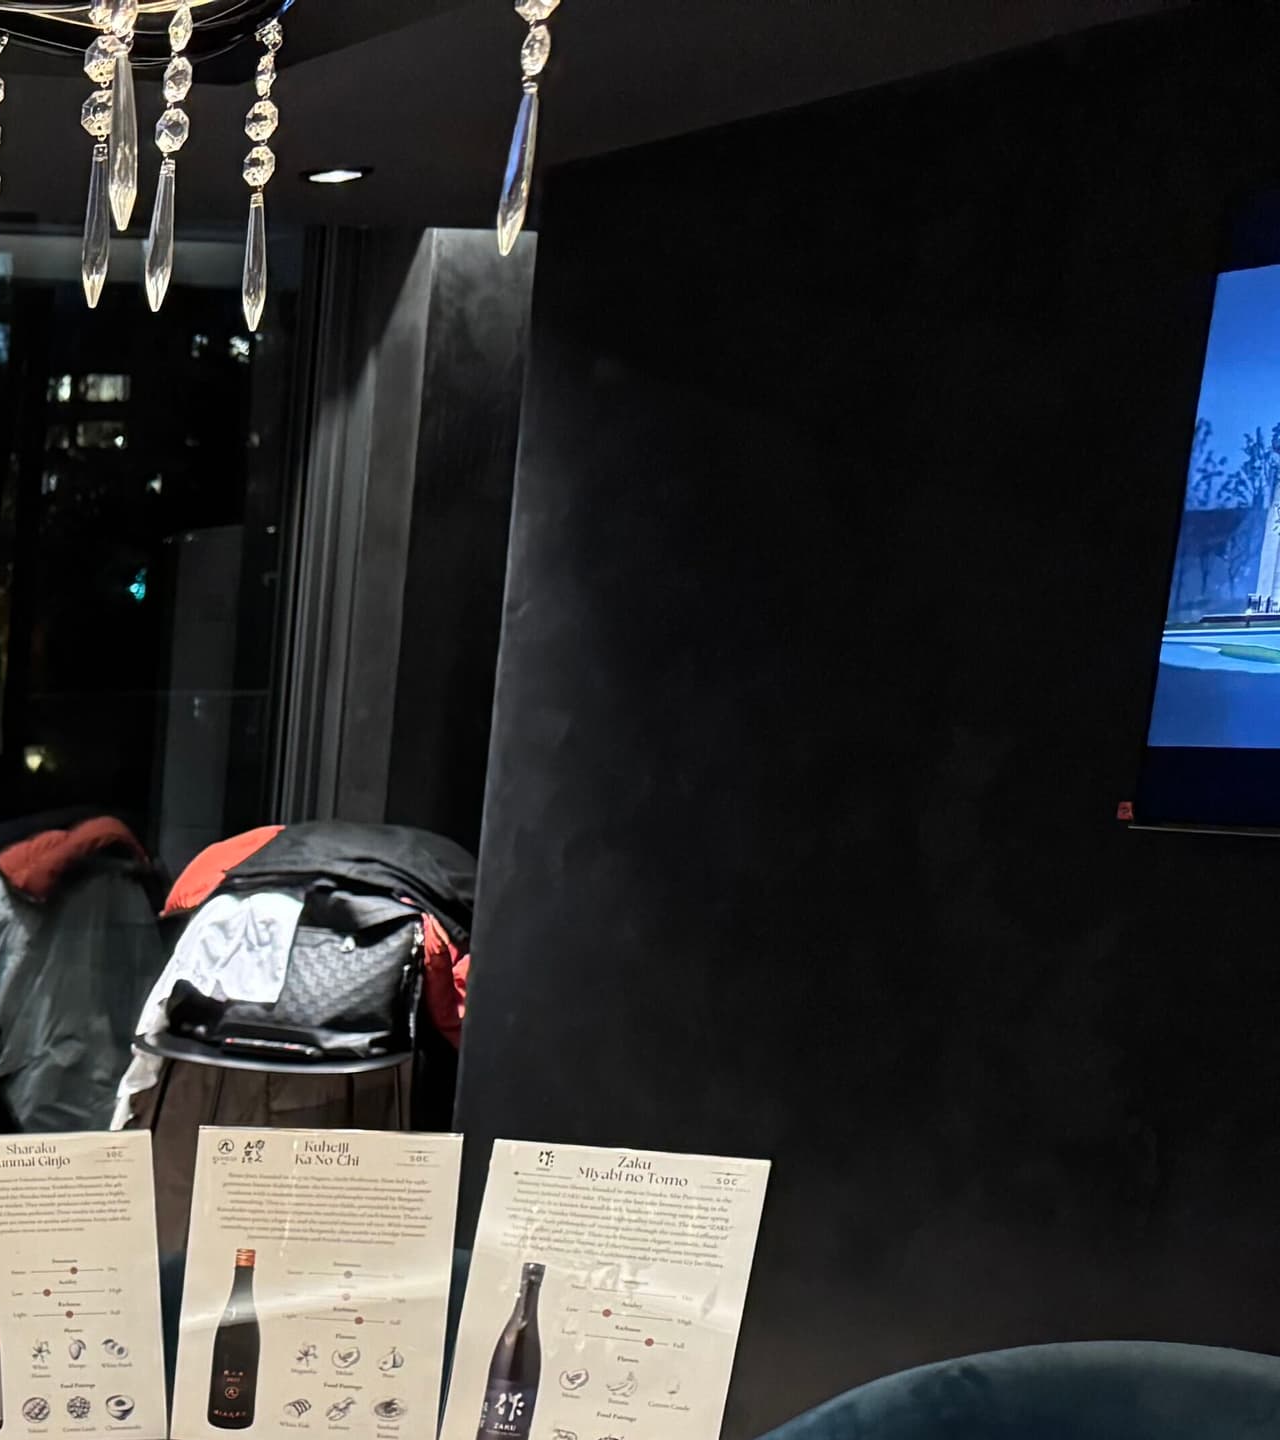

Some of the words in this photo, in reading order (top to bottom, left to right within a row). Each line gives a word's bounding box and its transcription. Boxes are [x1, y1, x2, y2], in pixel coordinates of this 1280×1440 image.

[6, 1142, 56, 1154] Sharaku
[304, 1141, 349, 1155] Kuheiji
[38, 1156, 70, 1169] Ginjo
[296, 1154, 311, 1164] Ka
[316, 1155, 333, 1165] No
[337, 1154, 359, 1166] Chi
[618, 1156, 651, 1169] Zaku
[579, 1165, 622, 1181] Miyabi
[626, 1174, 643, 1182] no
[650, 1173, 688, 1186] Tomo
